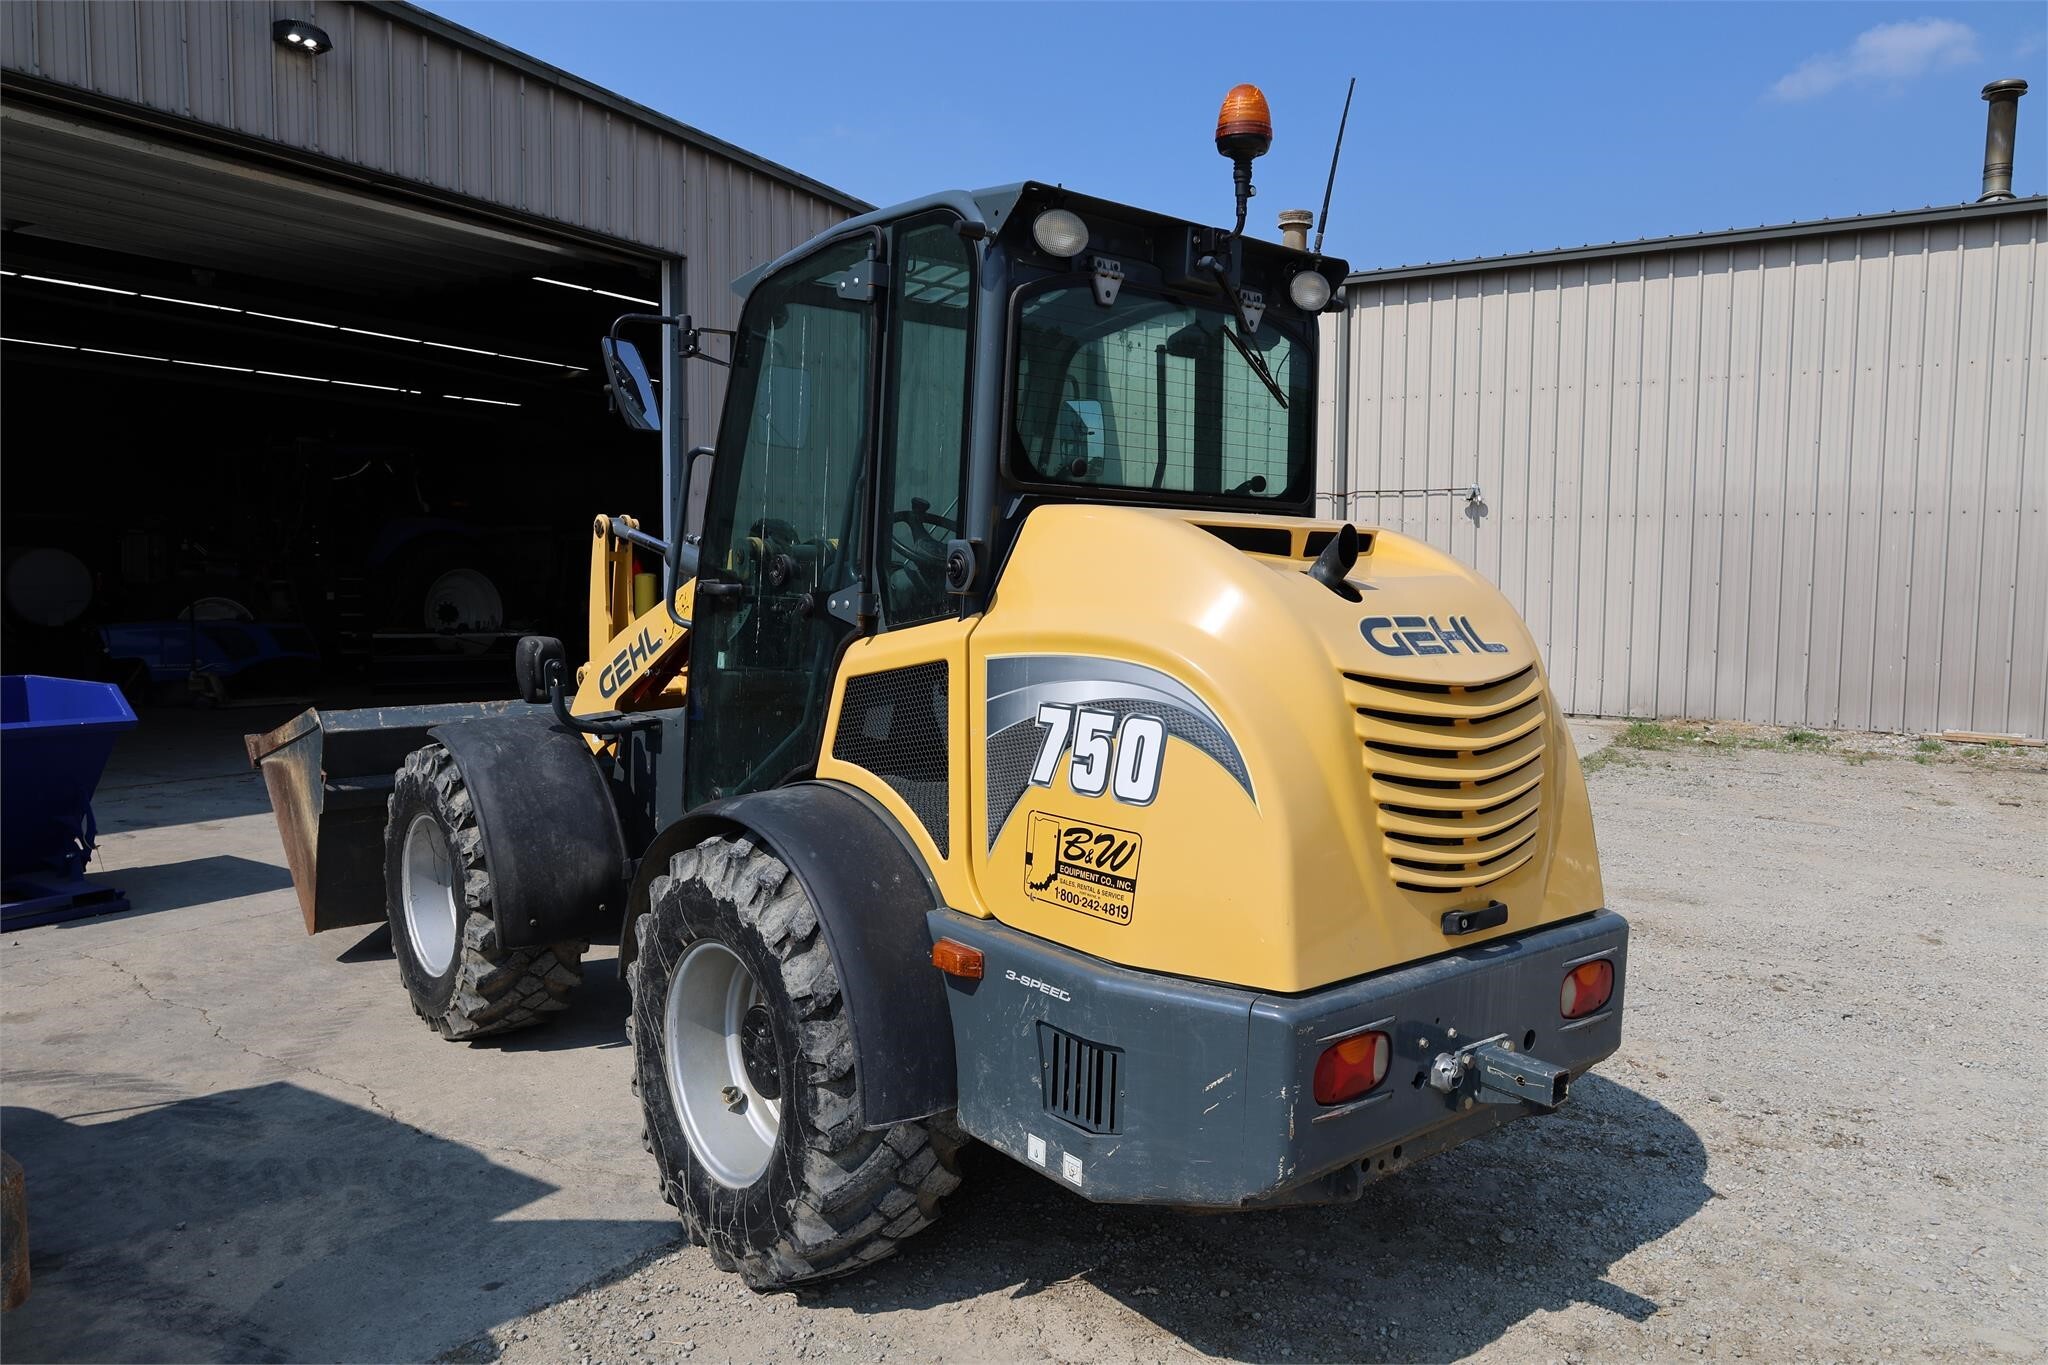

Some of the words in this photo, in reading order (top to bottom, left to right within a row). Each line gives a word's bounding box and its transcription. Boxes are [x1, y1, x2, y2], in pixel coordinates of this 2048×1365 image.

[1359, 616, 1508, 657] GEHL
[599, 626, 663, 699] GEHL
[1029, 702, 1168, 807] 750
[1063, 827, 1137, 872] B&W
[1060, 864, 1099, 883] EQUIPMENT
[1117, 879, 1133, 892] INC.
[1077, 882, 1096, 894] RENTAL
[1102, 889, 1125, 901] SERVICE
